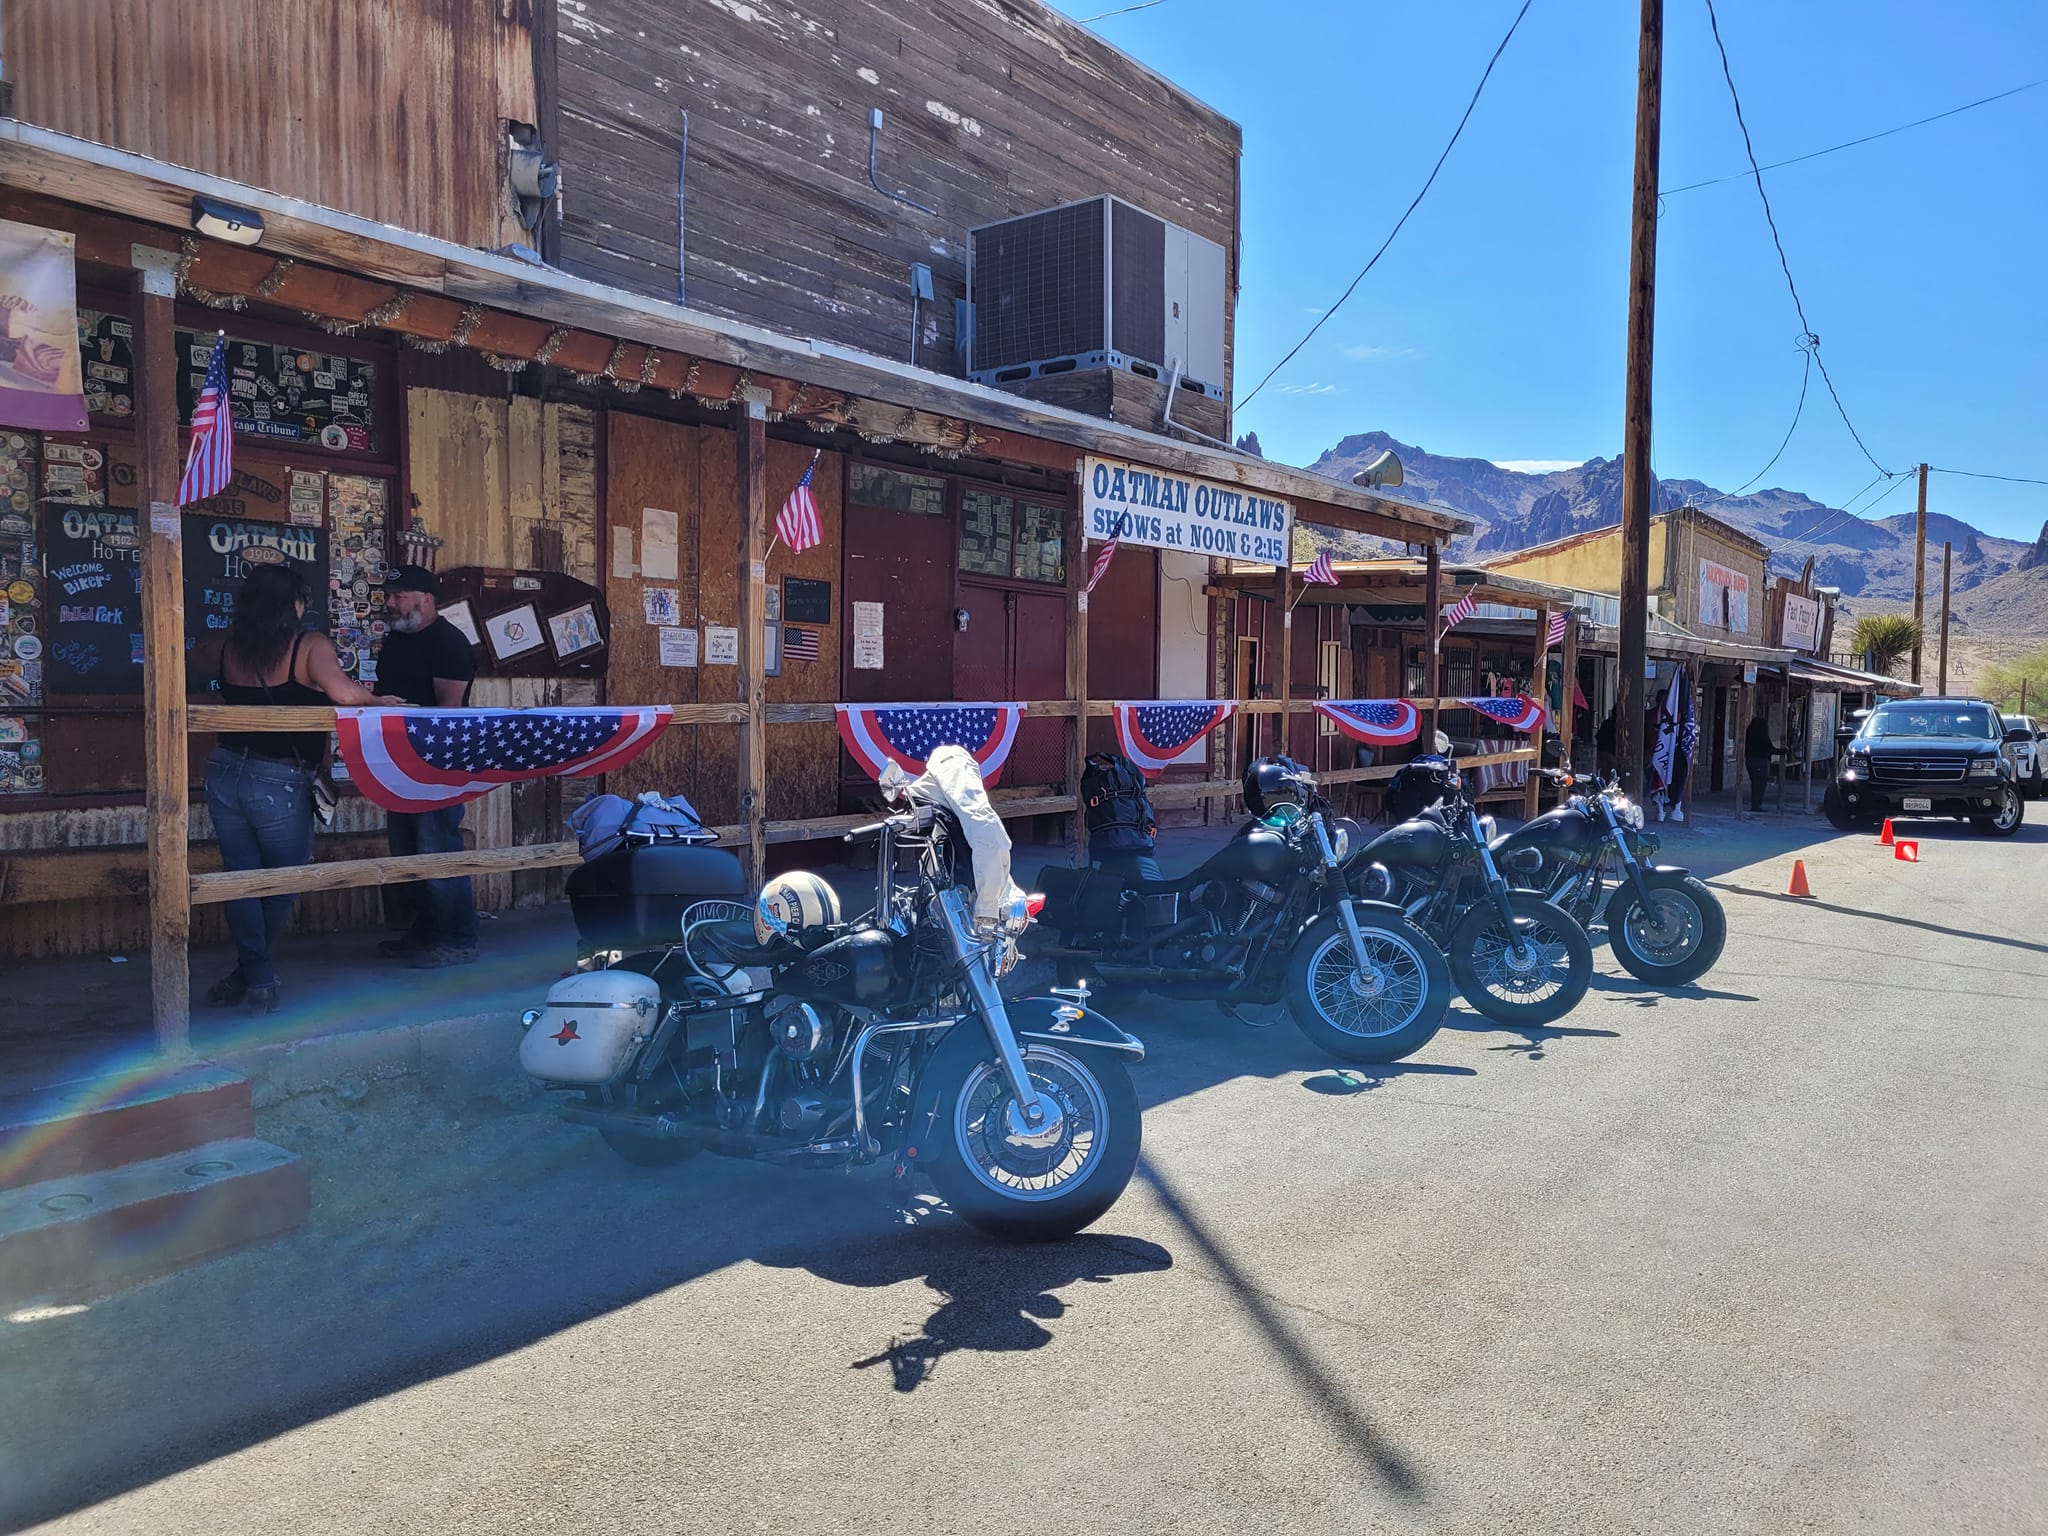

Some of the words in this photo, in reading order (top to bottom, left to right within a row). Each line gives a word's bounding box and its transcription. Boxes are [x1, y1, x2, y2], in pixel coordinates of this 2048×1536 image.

[231, 378, 258, 397] 2MUCH
[233, 421, 255, 432] cago
[257, 421, 297, 436] Tribune
[1092, 463, 1190, 514] OATMAN
[1194, 485, 1285, 532] OUTLAWS
[62, 510, 140, 539] OATM
[1093, 507, 1162, 542] SHOWS
[1165, 524, 1183, 545] at
[1190, 524, 1236, 554] NOON
[1240, 533, 1252, 556] &
[1254, 536, 1283, 562] 2:15
[93, 540, 141, 562] HOTE
[110, 535, 133, 546] 1902
[208, 522, 317, 562] OATMAN
[248, 549, 278, 561] 1902
[63, 573, 113, 596] Bikers
[95, 605, 123, 625] Pork
[791, 902, 801, 917] PIER
